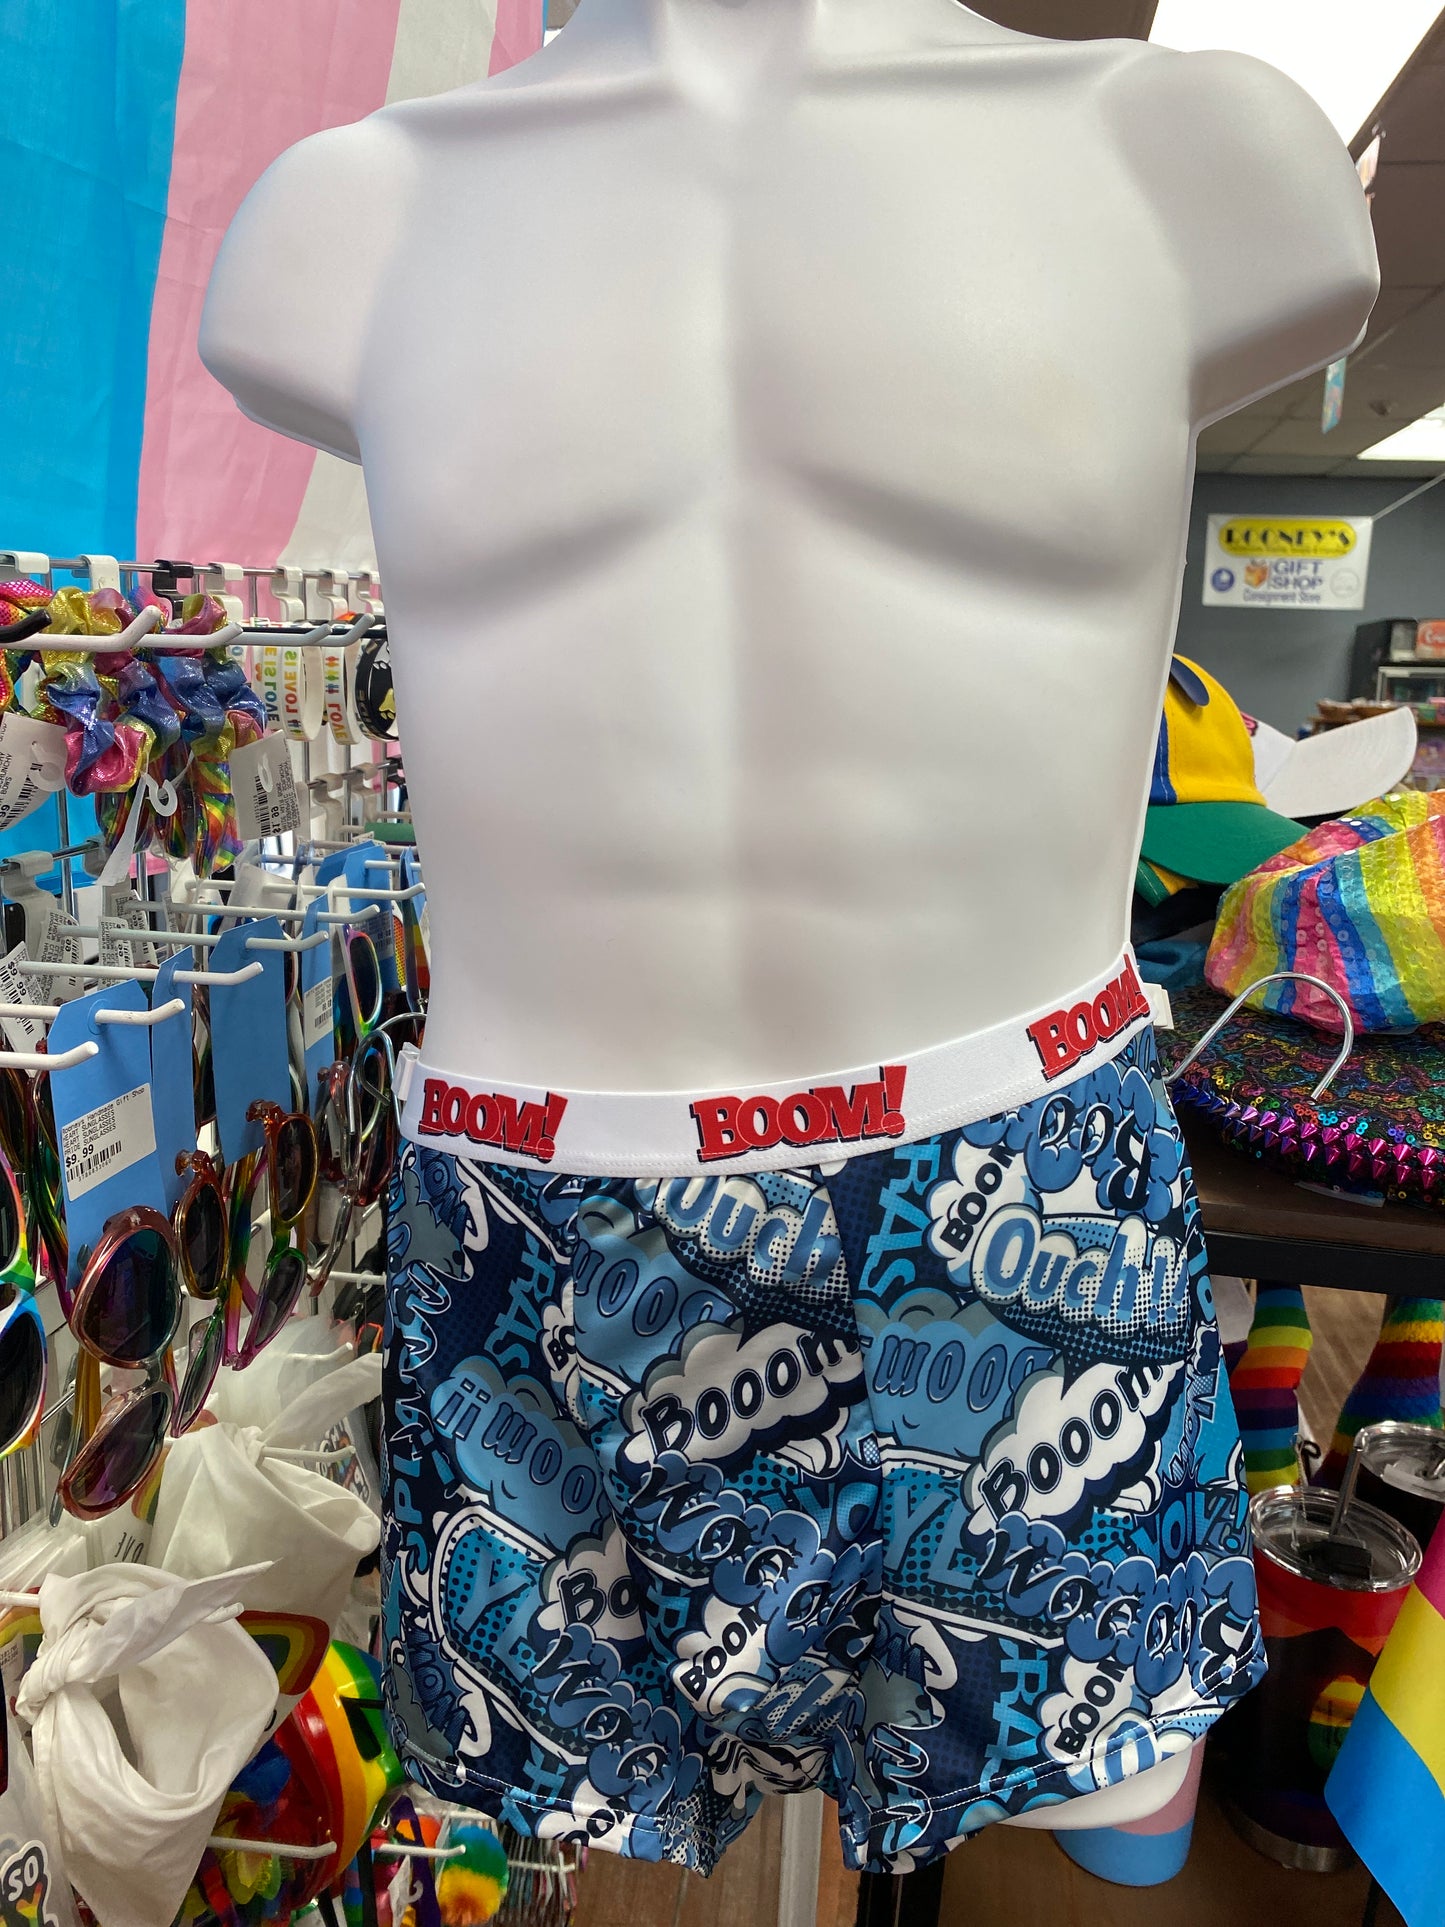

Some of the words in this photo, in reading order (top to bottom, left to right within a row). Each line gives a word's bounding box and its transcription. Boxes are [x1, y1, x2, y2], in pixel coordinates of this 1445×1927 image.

[1270, 576, 1323, 590] SHOP
[1273, 559, 1322, 575] GIFT
[1026, 953, 1150, 1082] BOOM!
[87, 1103, 114, 1120] Handmade
[116, 1095, 129, 1106] Gift
[132, 1087, 145, 1098] Shop
[689, 1065, 907, 1162] BOOM!
[81, 1109, 115, 1132] SUNGLASSES
[82, 1117, 116, 1139] SUNGLASSES
[418, 1078, 568, 1163] BOOM!
[64, 1142, 81, 1156] PRIDE
[83, 1124, 117, 1146] SUNGLASSES
